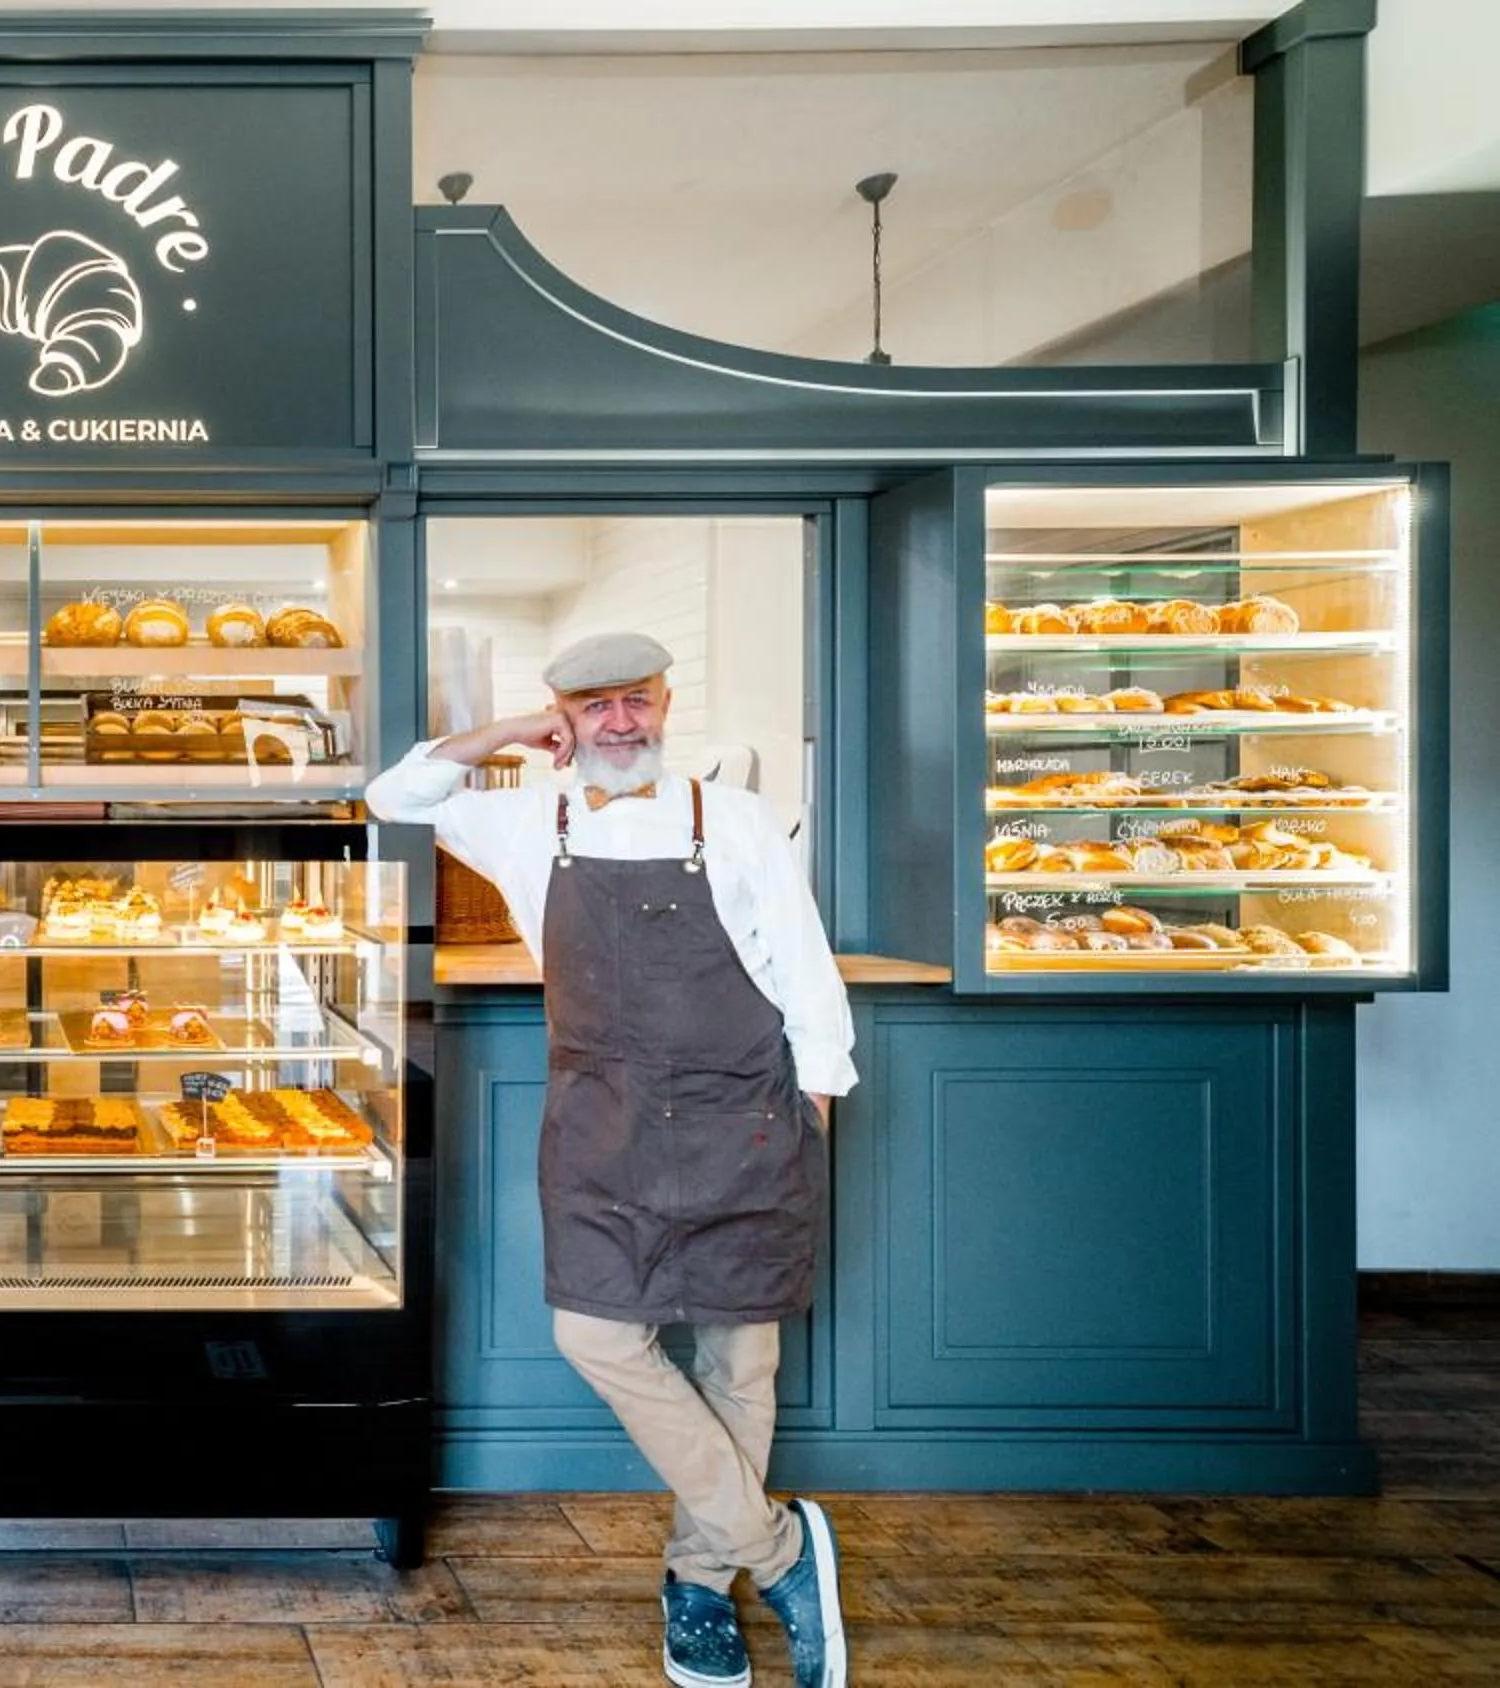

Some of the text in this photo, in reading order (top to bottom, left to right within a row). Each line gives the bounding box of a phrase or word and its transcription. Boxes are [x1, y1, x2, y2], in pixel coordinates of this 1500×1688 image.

[3, 104, 209, 273] Padre
[23, 419, 41, 442] &
[48, 419, 209, 442] CUKIERNIA
[1141, 770, 1194, 787] SEREK
